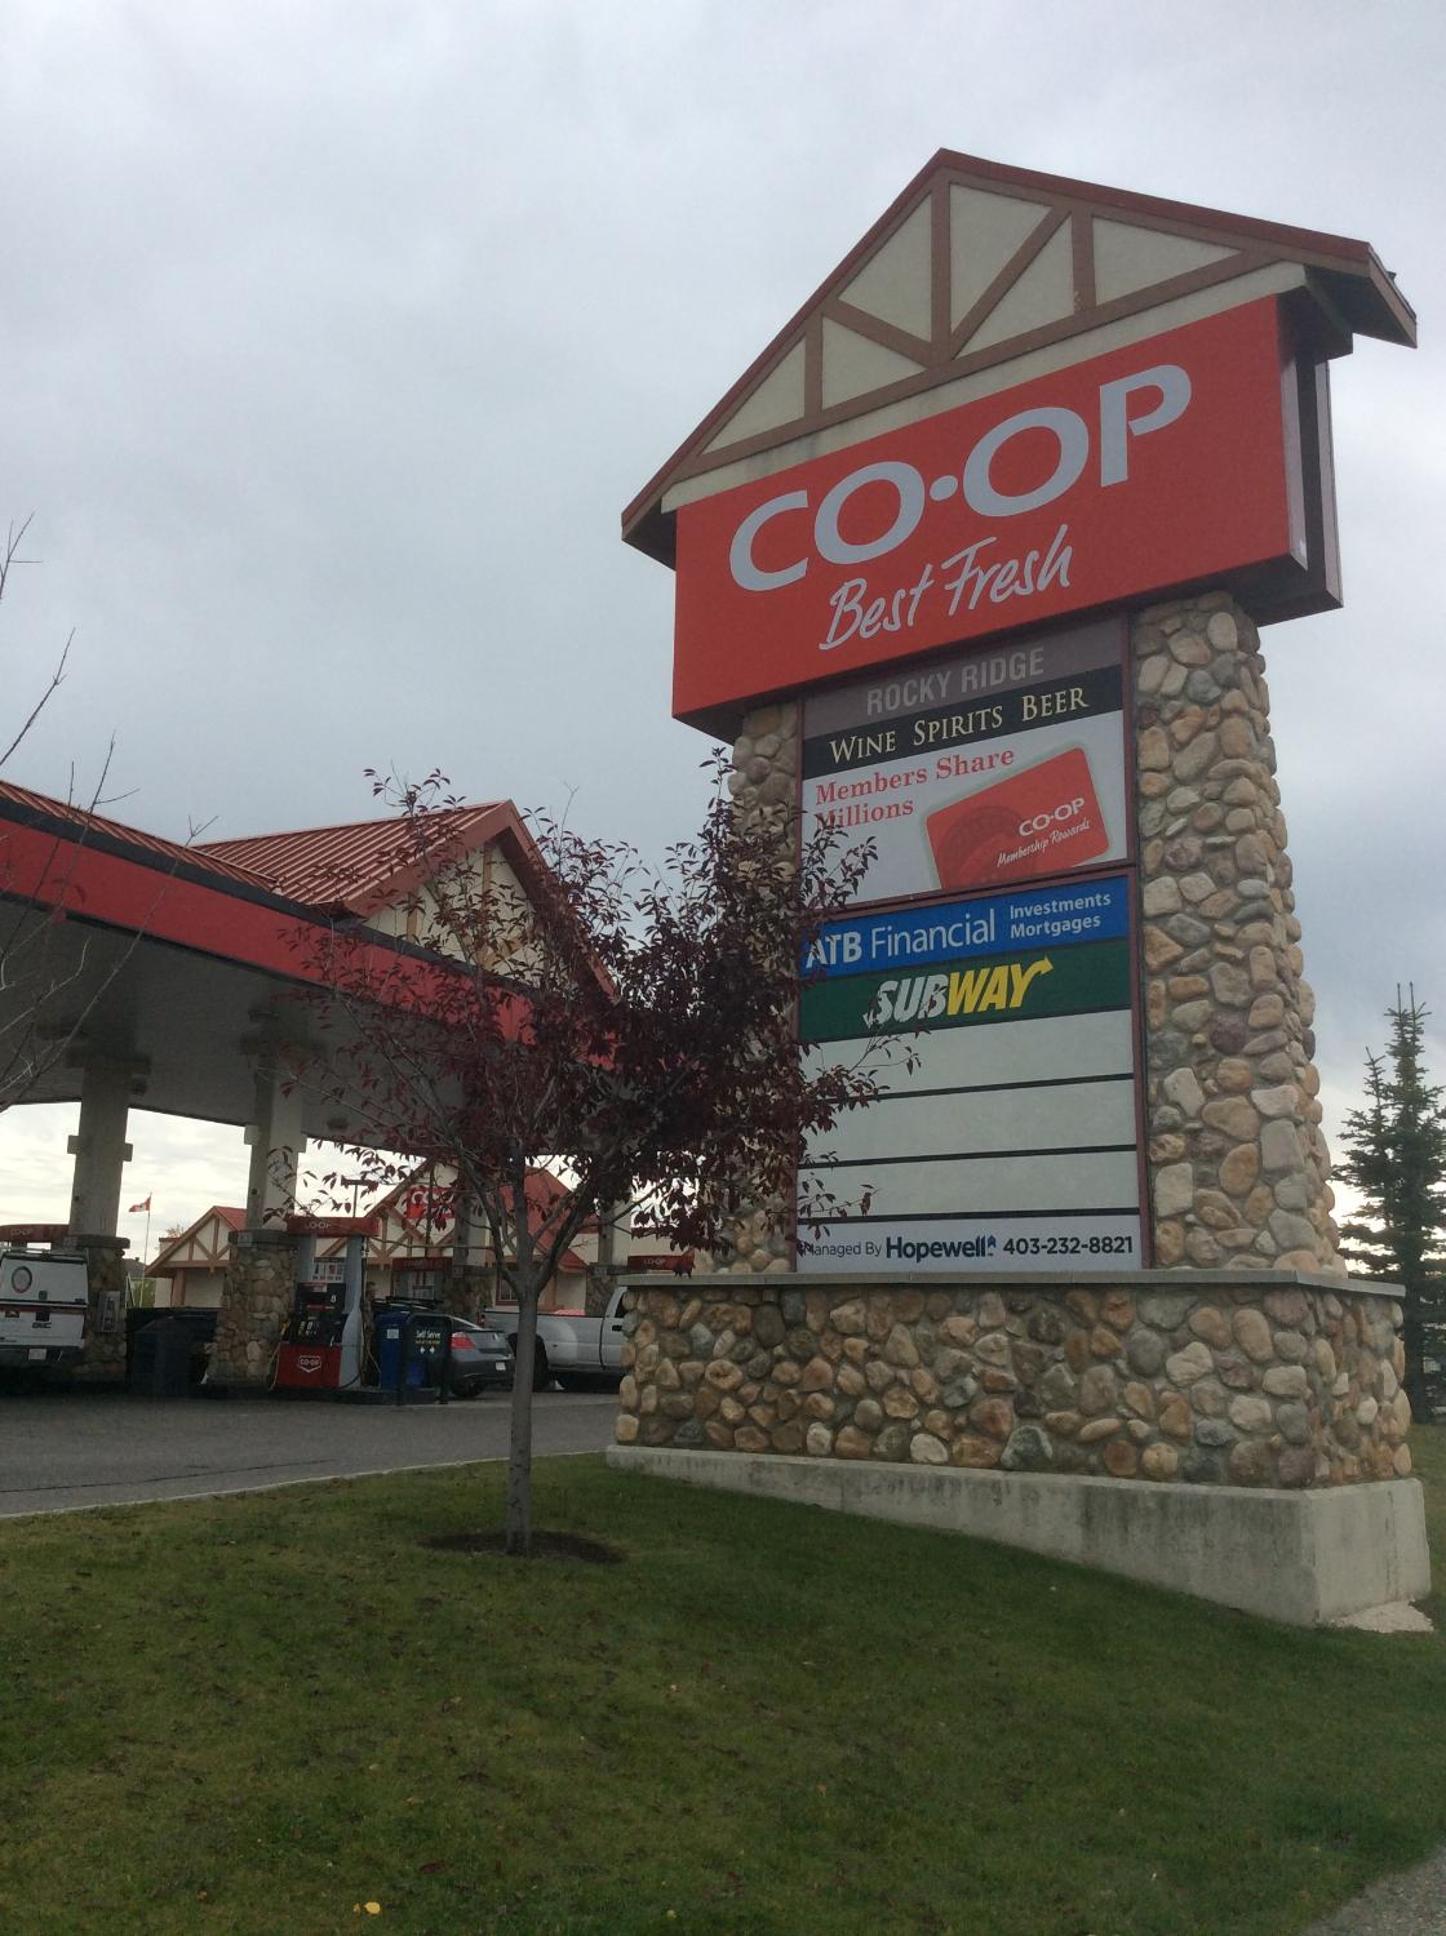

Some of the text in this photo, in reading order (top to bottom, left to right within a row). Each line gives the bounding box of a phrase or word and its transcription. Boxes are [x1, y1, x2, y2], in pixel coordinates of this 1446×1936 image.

[818, 524, 1071, 650] Best Fresh
[866, 648, 1045, 716] ROCKY RIDGE
[816, 750, 1015, 805] Members Share
[815, 799, 914, 832] Millions
[997, 817, 1090, 868] Membership Rewards
[1010, 893, 1111, 919] Investments
[1010, 914, 1101, 940] Mortgages
[805, 908, 996, 969] ATB Financial
[863, 955, 1054, 1029] SUBWAY
[865, 1241, 882, 1257] By
[886, 1235, 986, 1263] Hopewell
[1003, 1236, 1133, 1256] 403-232-8821
